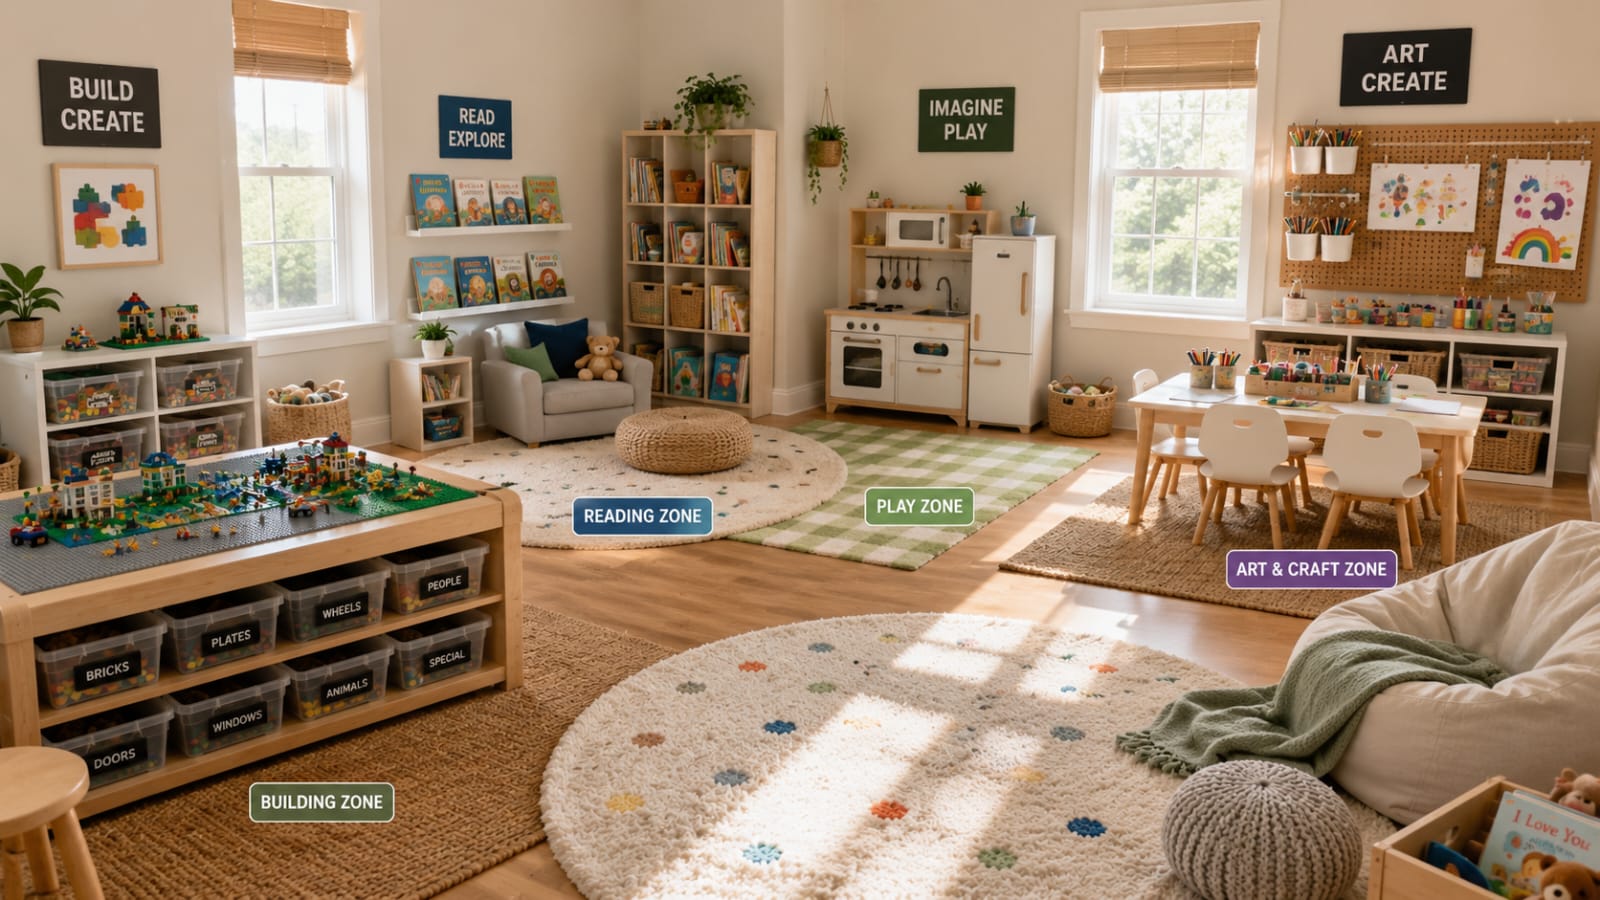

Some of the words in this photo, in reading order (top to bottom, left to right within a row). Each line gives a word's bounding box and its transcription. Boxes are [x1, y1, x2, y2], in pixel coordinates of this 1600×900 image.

[1382, 43, 1429, 64] ART
[69, 76, 134, 102] BUILD
[1361, 70, 1448, 93] CREATE
[459, 107, 495, 126] READ
[929, 98, 1004, 117] IMAGINE
[61, 107, 145, 133] CREATE
[448, 130, 506, 149] EXPLORE
[944, 122, 988, 141] PLAY
[427, 575, 462, 591] PEOPLE
[322, 601, 362, 619] WHEELS
[211, 629, 251, 648] PLATES
[429, 650, 466, 668] SPECIAL
[86, 661, 130, 682] BRICKS
[326, 678, 368, 698] ANIMALS
[212, 710, 263, 733] WINDOWS
[94, 747, 136, 770] DOORS
[1513, 809, 1522, 823] I
[1525, 813, 1559, 837] Love
[1564, 828, 1591, 851] You
